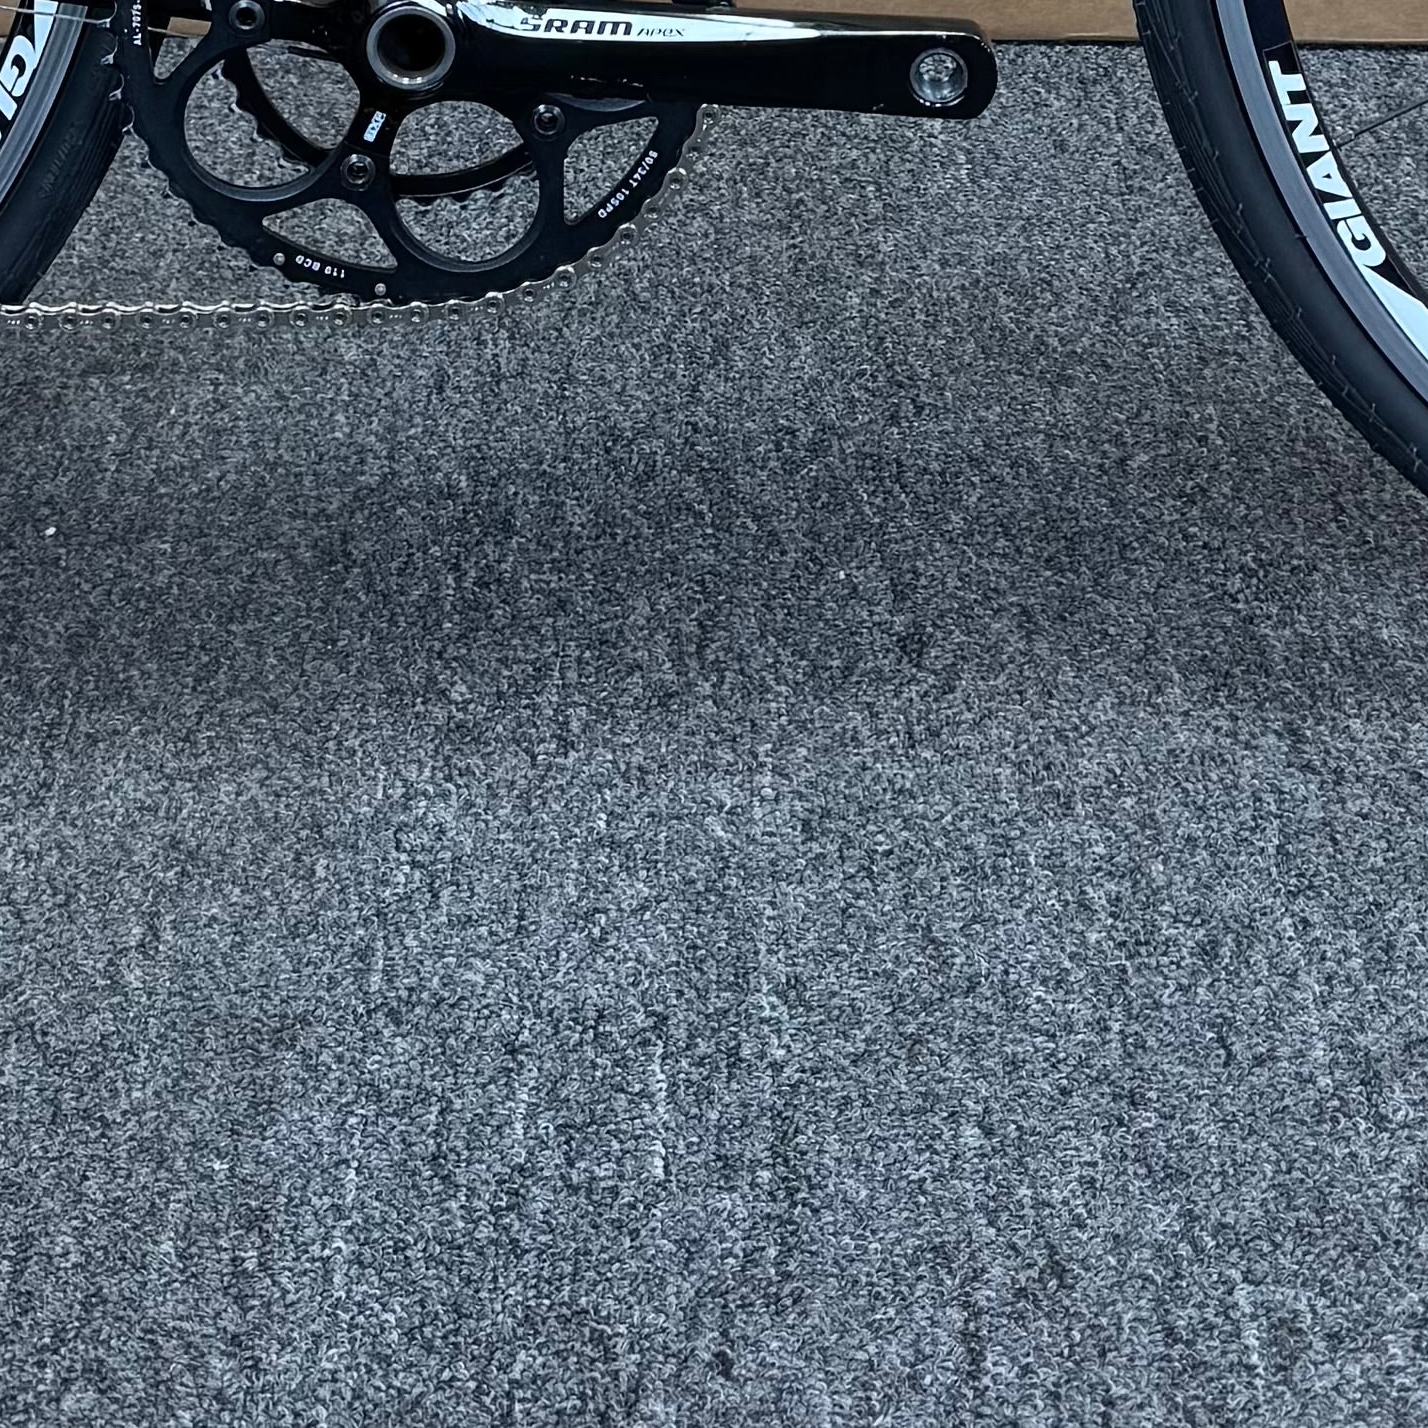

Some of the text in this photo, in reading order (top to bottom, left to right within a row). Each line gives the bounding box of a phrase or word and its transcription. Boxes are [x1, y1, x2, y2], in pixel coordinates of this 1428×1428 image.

[520, 17, 633, 36] SRAM
[1268, 60, 1387, 268] GIANT
[295, 254, 321, 271] BCD
